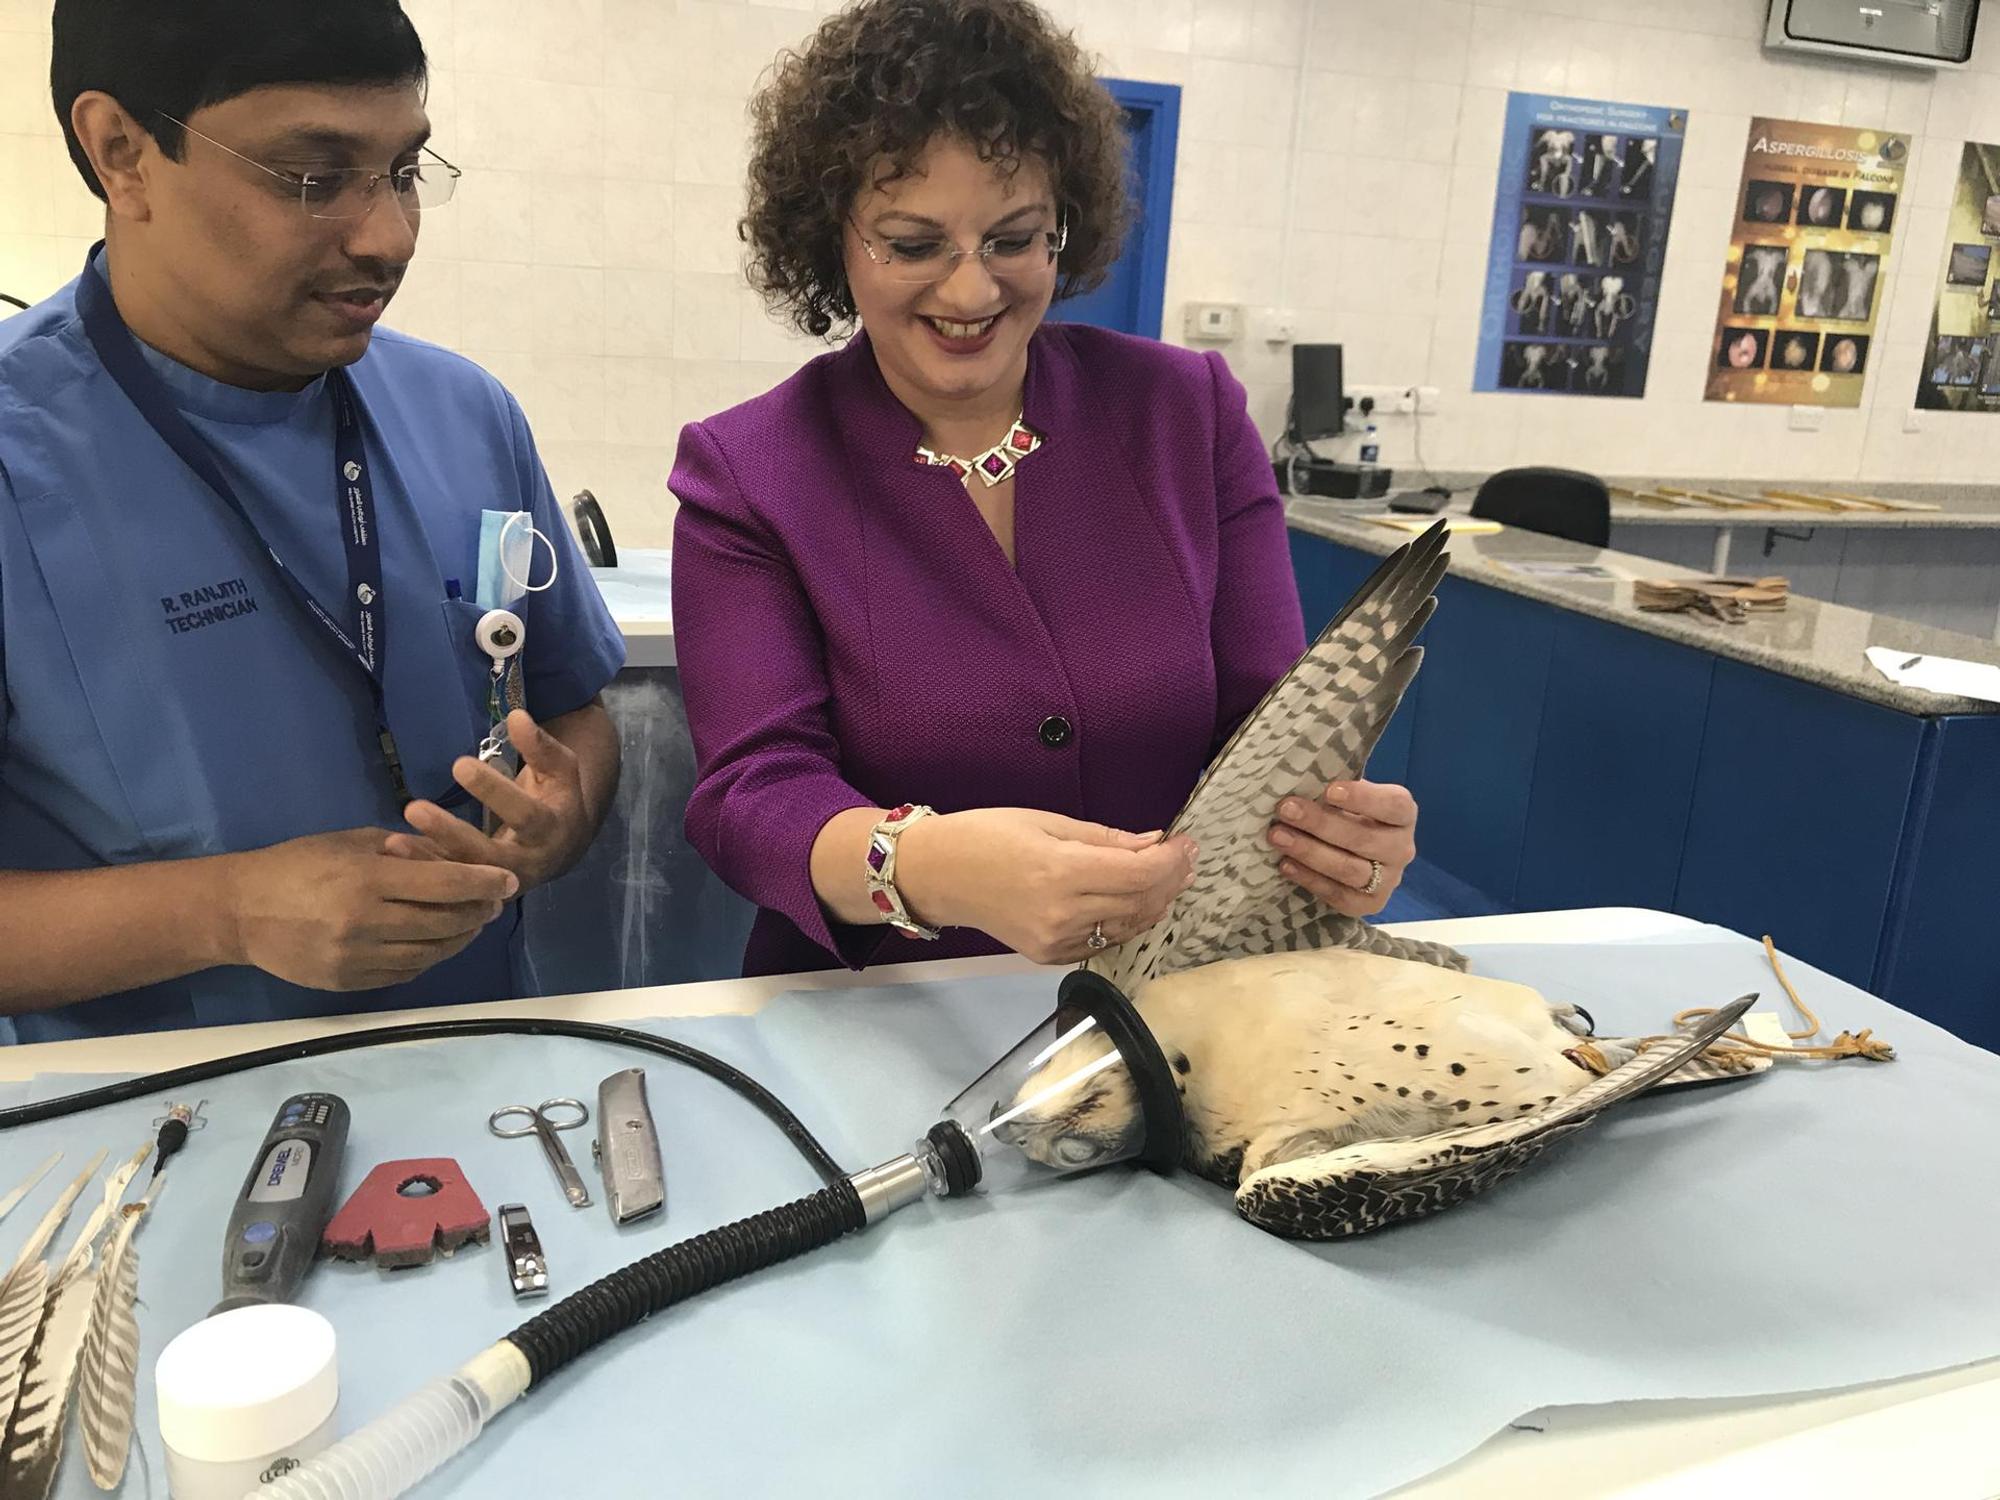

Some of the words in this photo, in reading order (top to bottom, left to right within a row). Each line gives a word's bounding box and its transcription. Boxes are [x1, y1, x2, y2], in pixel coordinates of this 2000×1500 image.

[1752, 136, 1867, 164] ASPERGILLOSIS
[160, 597, 180, 614] R.
[179, 578, 248, 609] RANJITH
[165, 597, 259, 634] TECHNICIAN
[267, 1147, 292, 1186] DREMEL
